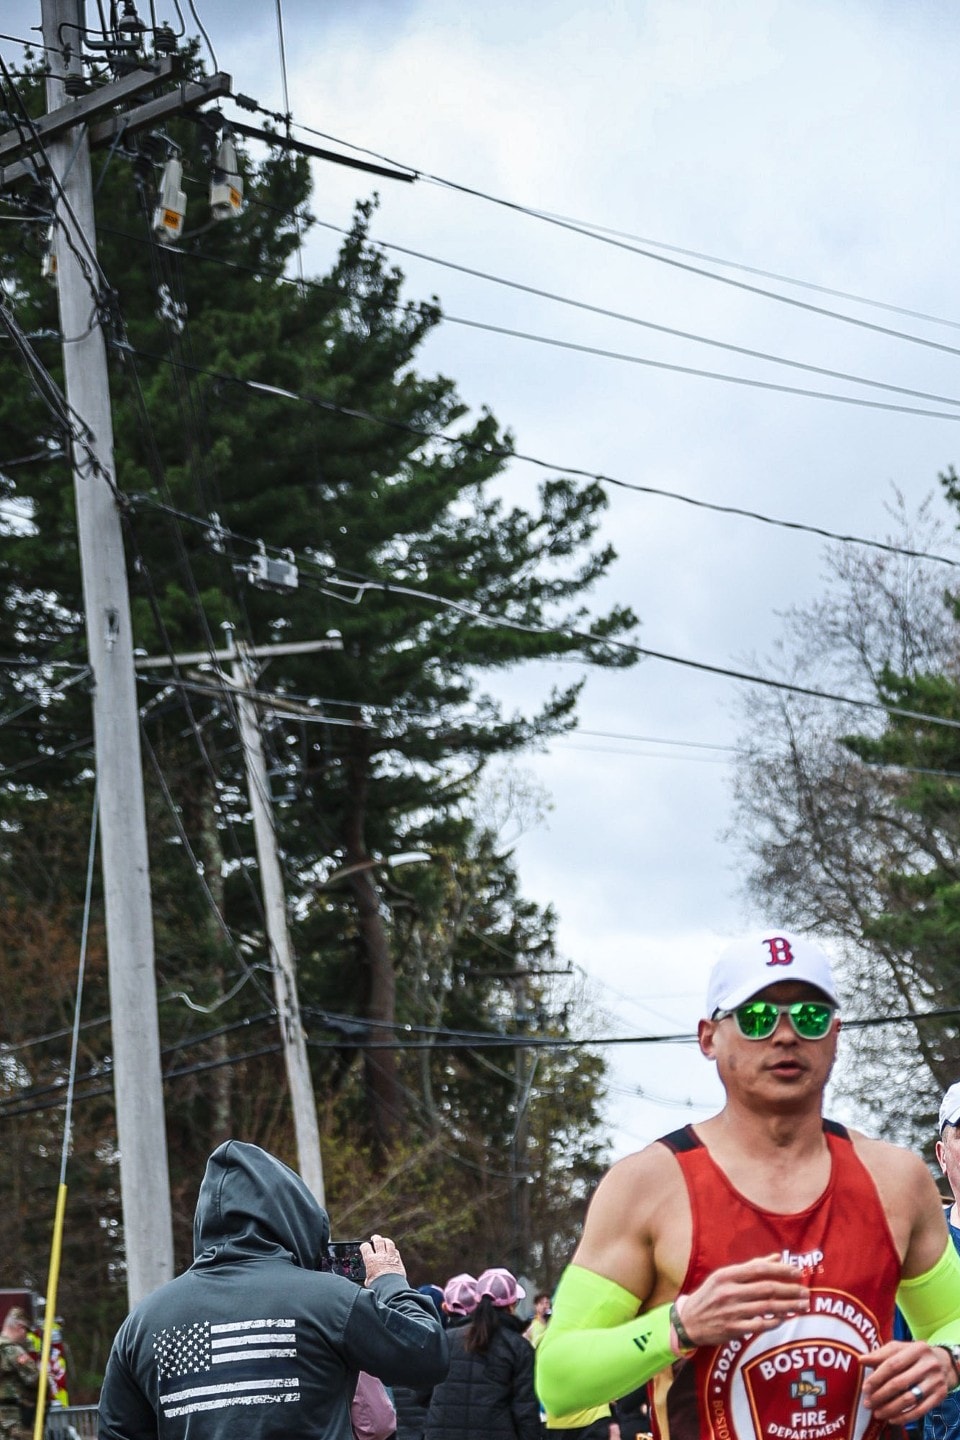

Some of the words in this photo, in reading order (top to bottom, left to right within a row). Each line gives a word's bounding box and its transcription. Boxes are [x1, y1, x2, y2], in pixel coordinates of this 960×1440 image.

[762, 937, 795, 966] B
[714, 1340, 742, 1382] 2026
[815, 1297, 882, 1353] MARATHO
[759, 1347, 852, 1381] BOSTON
[767, 1415, 846, 1440] DEPARTMENT
[791, 1410, 827, 1428] FIRE
